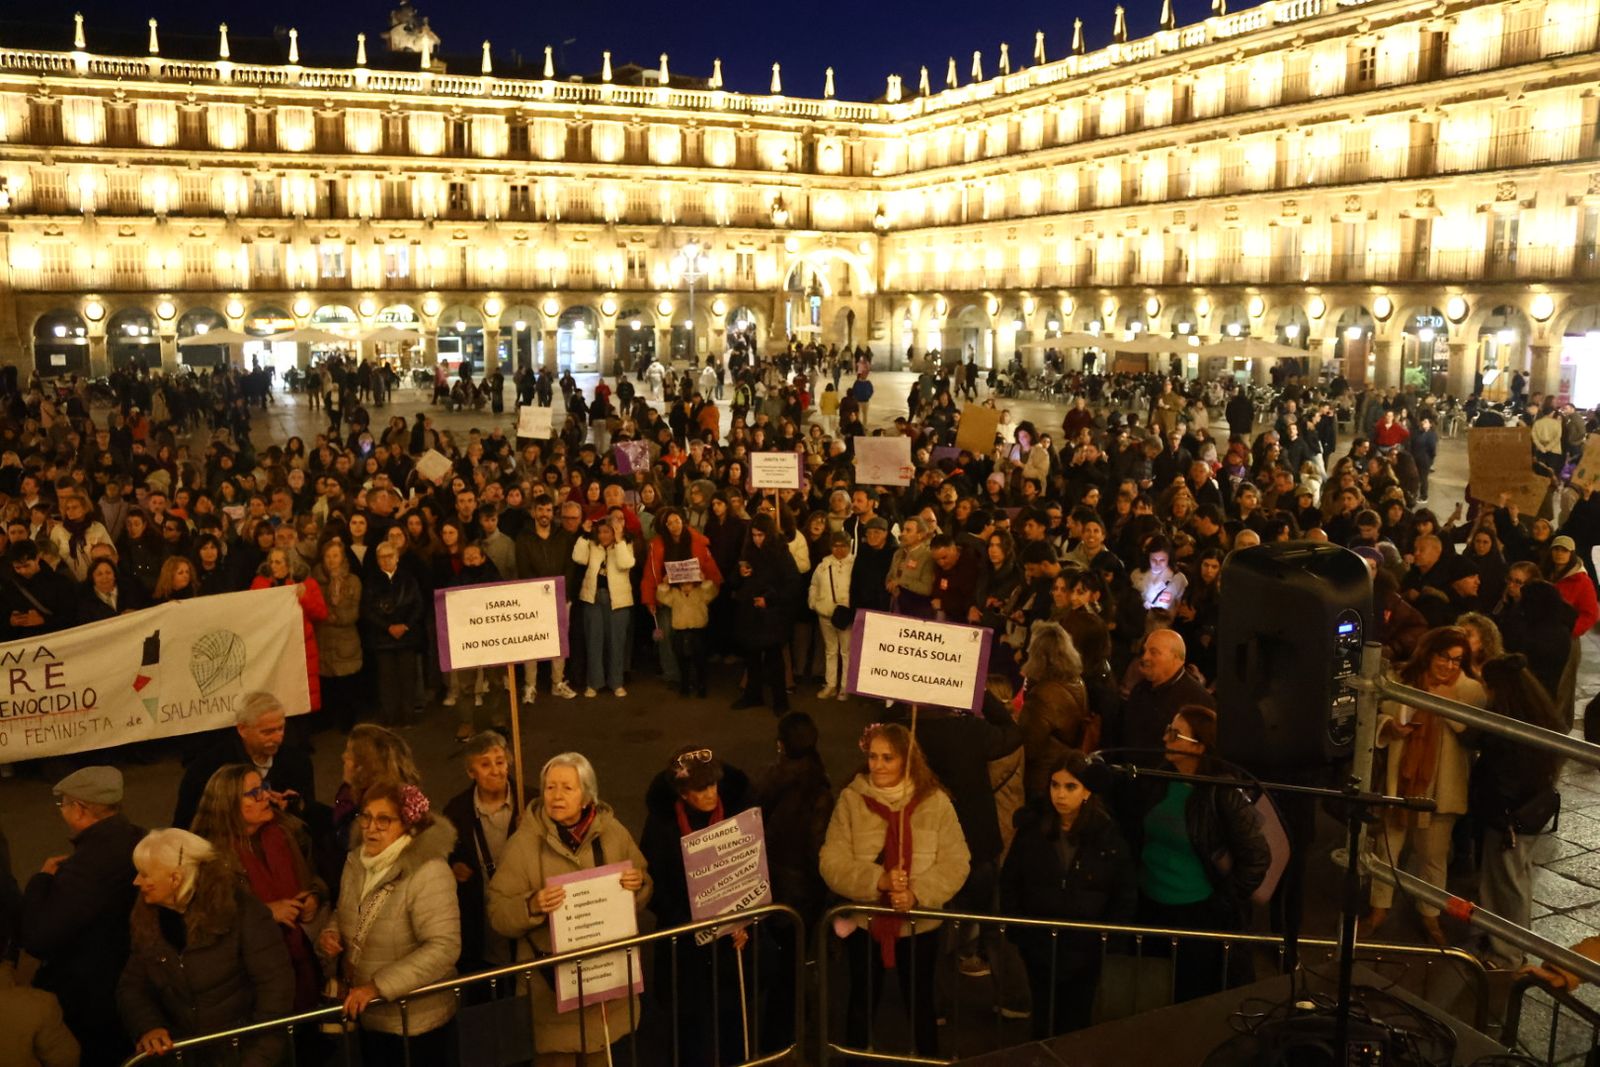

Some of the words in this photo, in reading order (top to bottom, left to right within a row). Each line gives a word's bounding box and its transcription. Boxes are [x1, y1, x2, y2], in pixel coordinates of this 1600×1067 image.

[485, 599, 521, 610] ¡SARAH,
[469, 617, 484, 626] NO
[485, 612, 512, 624] ESTÁS
[514, 611, 539, 621] SOLA!
[461, 640, 480, 651] ¡NO
[481, 636, 501, 648] NOS
[502, 633, 550, 645] CALLARÁN!
[898, 628, 945, 645] ¡SARAH,
[878, 642, 896, 653] NO
[897, 645, 928, 659] ESTÁS
[930, 650, 962, 663] SOLA!
[870, 667, 889, 677] ¡NO
[890, 669, 910, 681] NOS
[911, 674, 964, 689] CALLARÁN!
[24, 716, 113, 746] FEMINISTA
[126, 716, 144, 729] de
[702, 825, 739, 841] GUARDES
[713, 859, 730, 869] NOS
[717, 876, 734, 888] NOS
